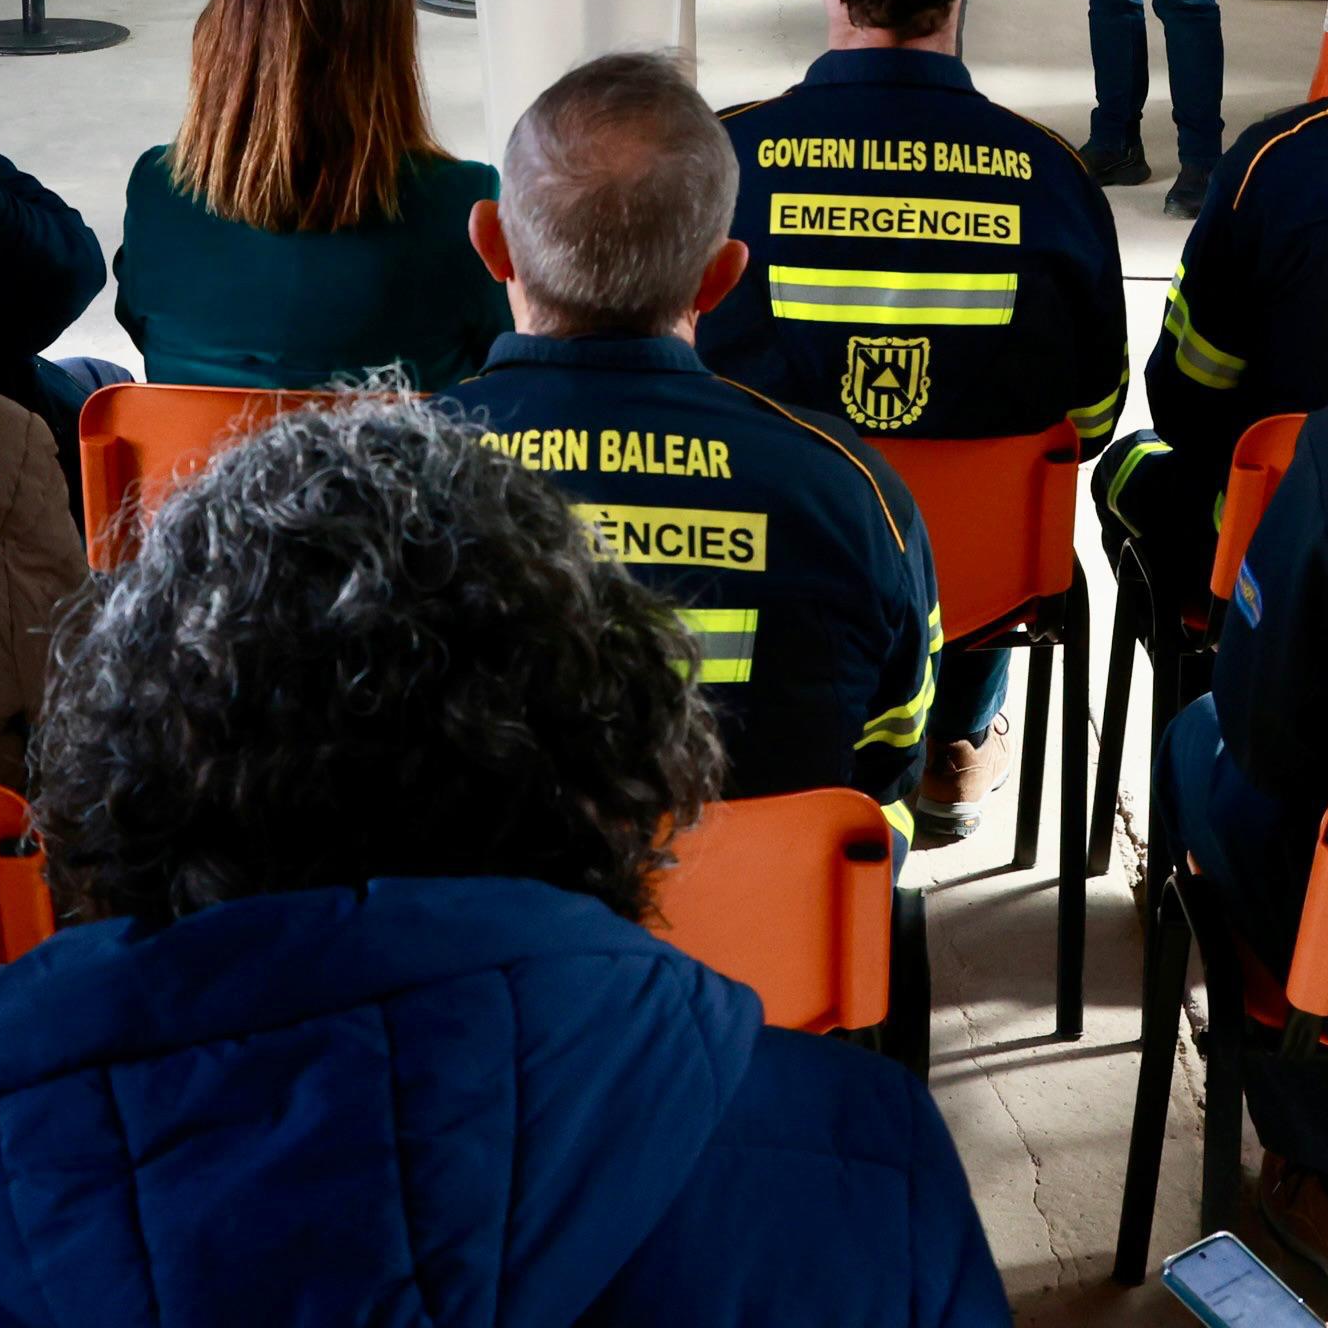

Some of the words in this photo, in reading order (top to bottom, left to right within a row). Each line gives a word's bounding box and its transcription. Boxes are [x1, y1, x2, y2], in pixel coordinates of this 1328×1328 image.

[757, 138, 855, 169] GOVERN
[862, 138, 928, 172] ILLES
[934, 141, 1032, 180] BALEARS
[779, 203, 1011, 239] EMERGÈNCIES
[599, 430, 732, 479] BALEAR
[593, 512, 755, 563] ÈNCIES
